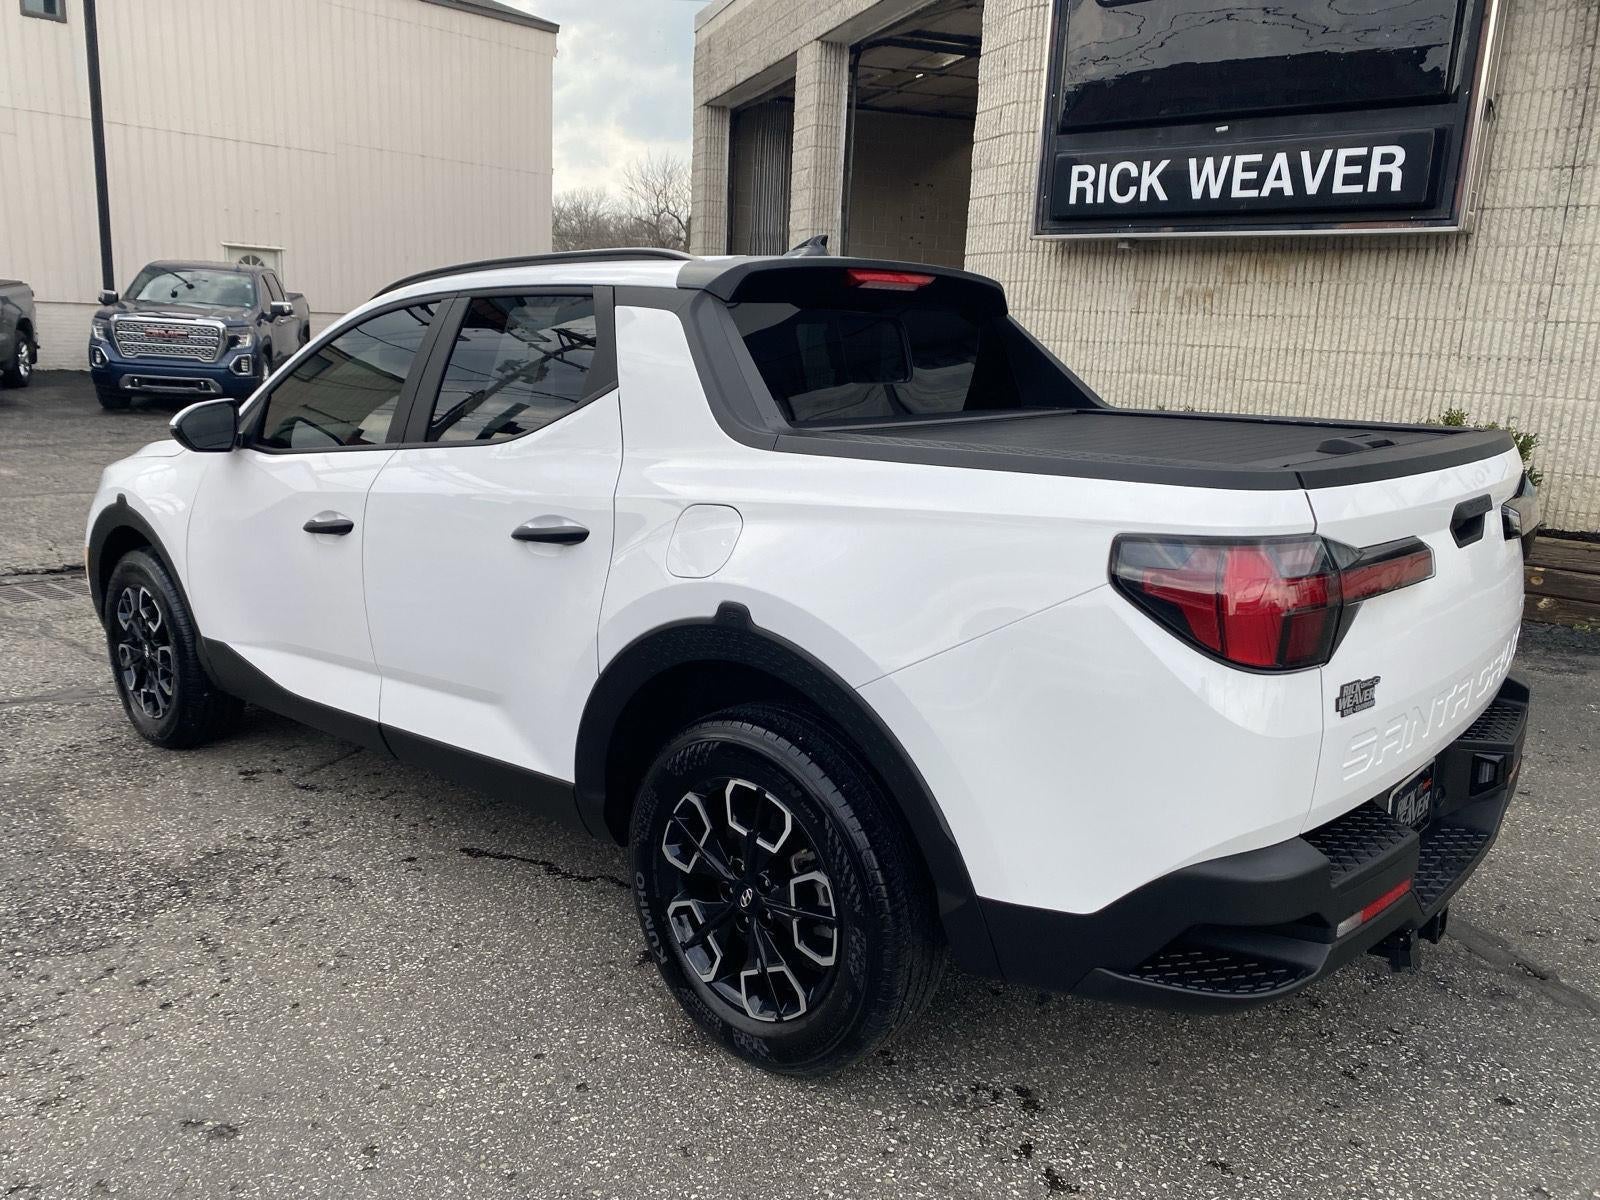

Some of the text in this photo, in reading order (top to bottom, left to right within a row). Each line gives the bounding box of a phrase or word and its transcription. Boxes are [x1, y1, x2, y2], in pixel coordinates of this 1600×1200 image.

[1069, 144, 1407, 205] RICK WEAVER
[1339, 687, 1375, 711] WEAVER
[1342, 681, 1361, 698] RICK
[1342, 671, 1475, 782] SANTA
[635, 871, 668, 965] KUMHO
